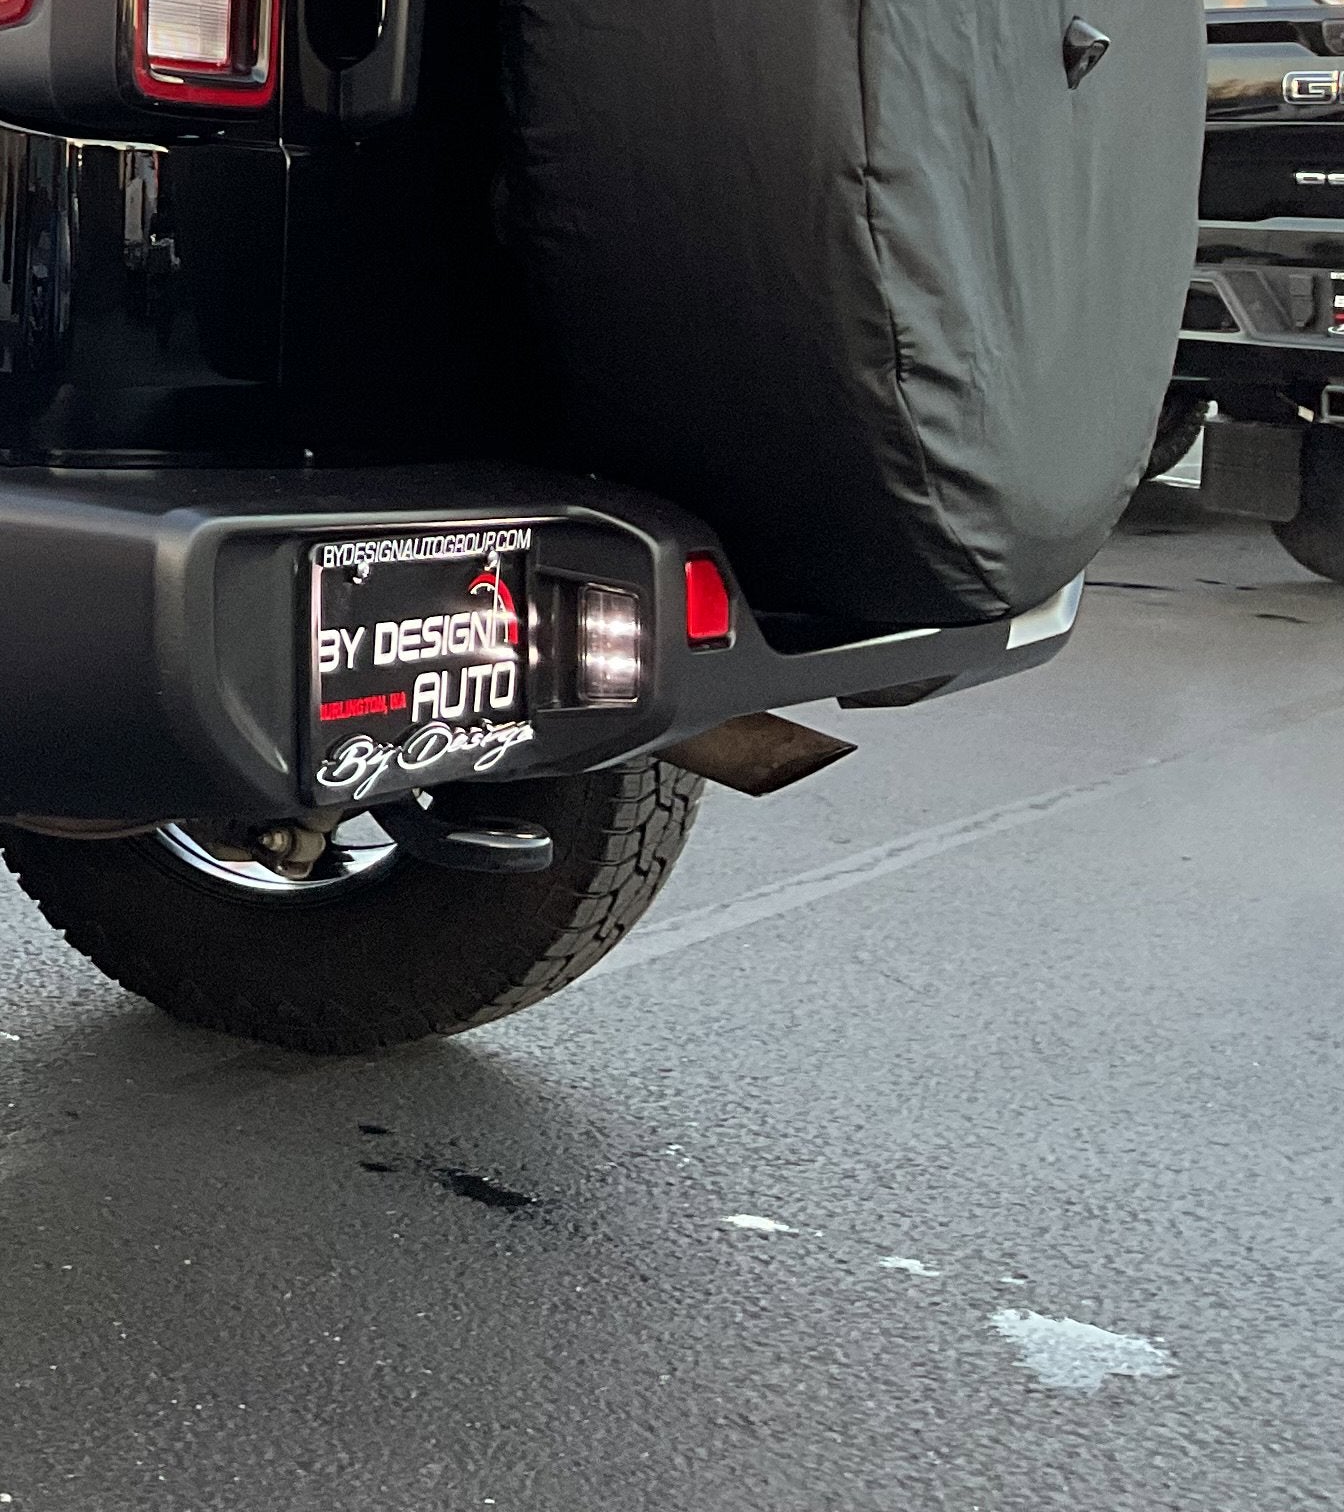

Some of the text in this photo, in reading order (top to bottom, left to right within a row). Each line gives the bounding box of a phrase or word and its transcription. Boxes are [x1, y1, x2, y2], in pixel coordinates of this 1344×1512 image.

[318, 609, 494, 673] BY DESIGN
[411, 660, 516, 723] AUTO
[316, 737, 396, 800] By
